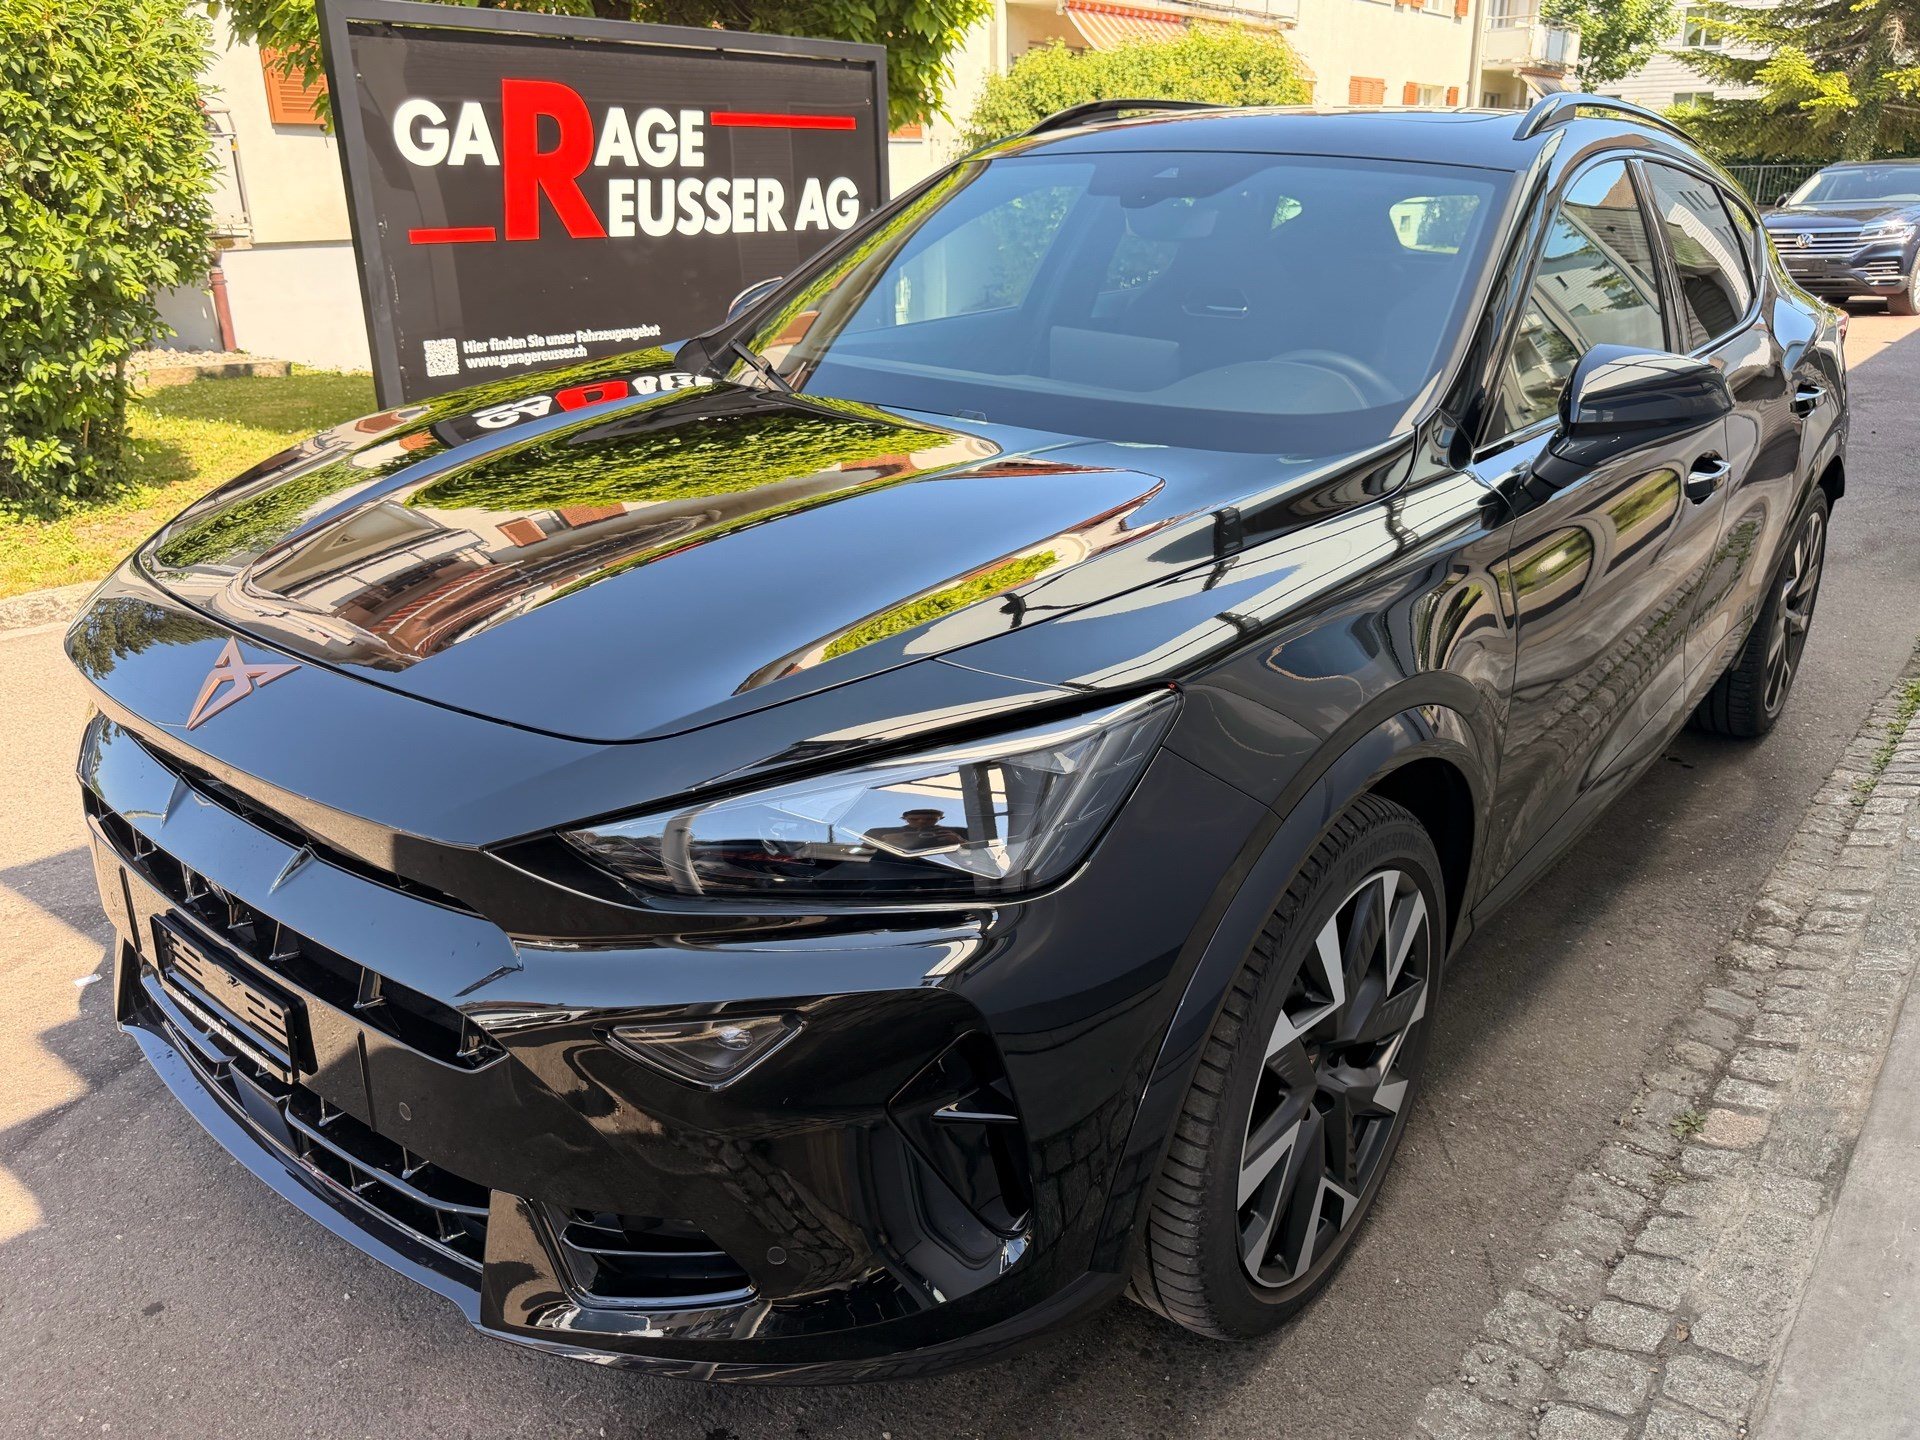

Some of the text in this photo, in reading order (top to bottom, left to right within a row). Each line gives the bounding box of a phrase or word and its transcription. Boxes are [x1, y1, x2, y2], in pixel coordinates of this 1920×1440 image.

[794, 176, 859, 231] AG
[462, 324, 661, 354] Hier finden Sie unser Fahrzeugangebot
[465, 344, 588, 369] www.garagereusser.ch
